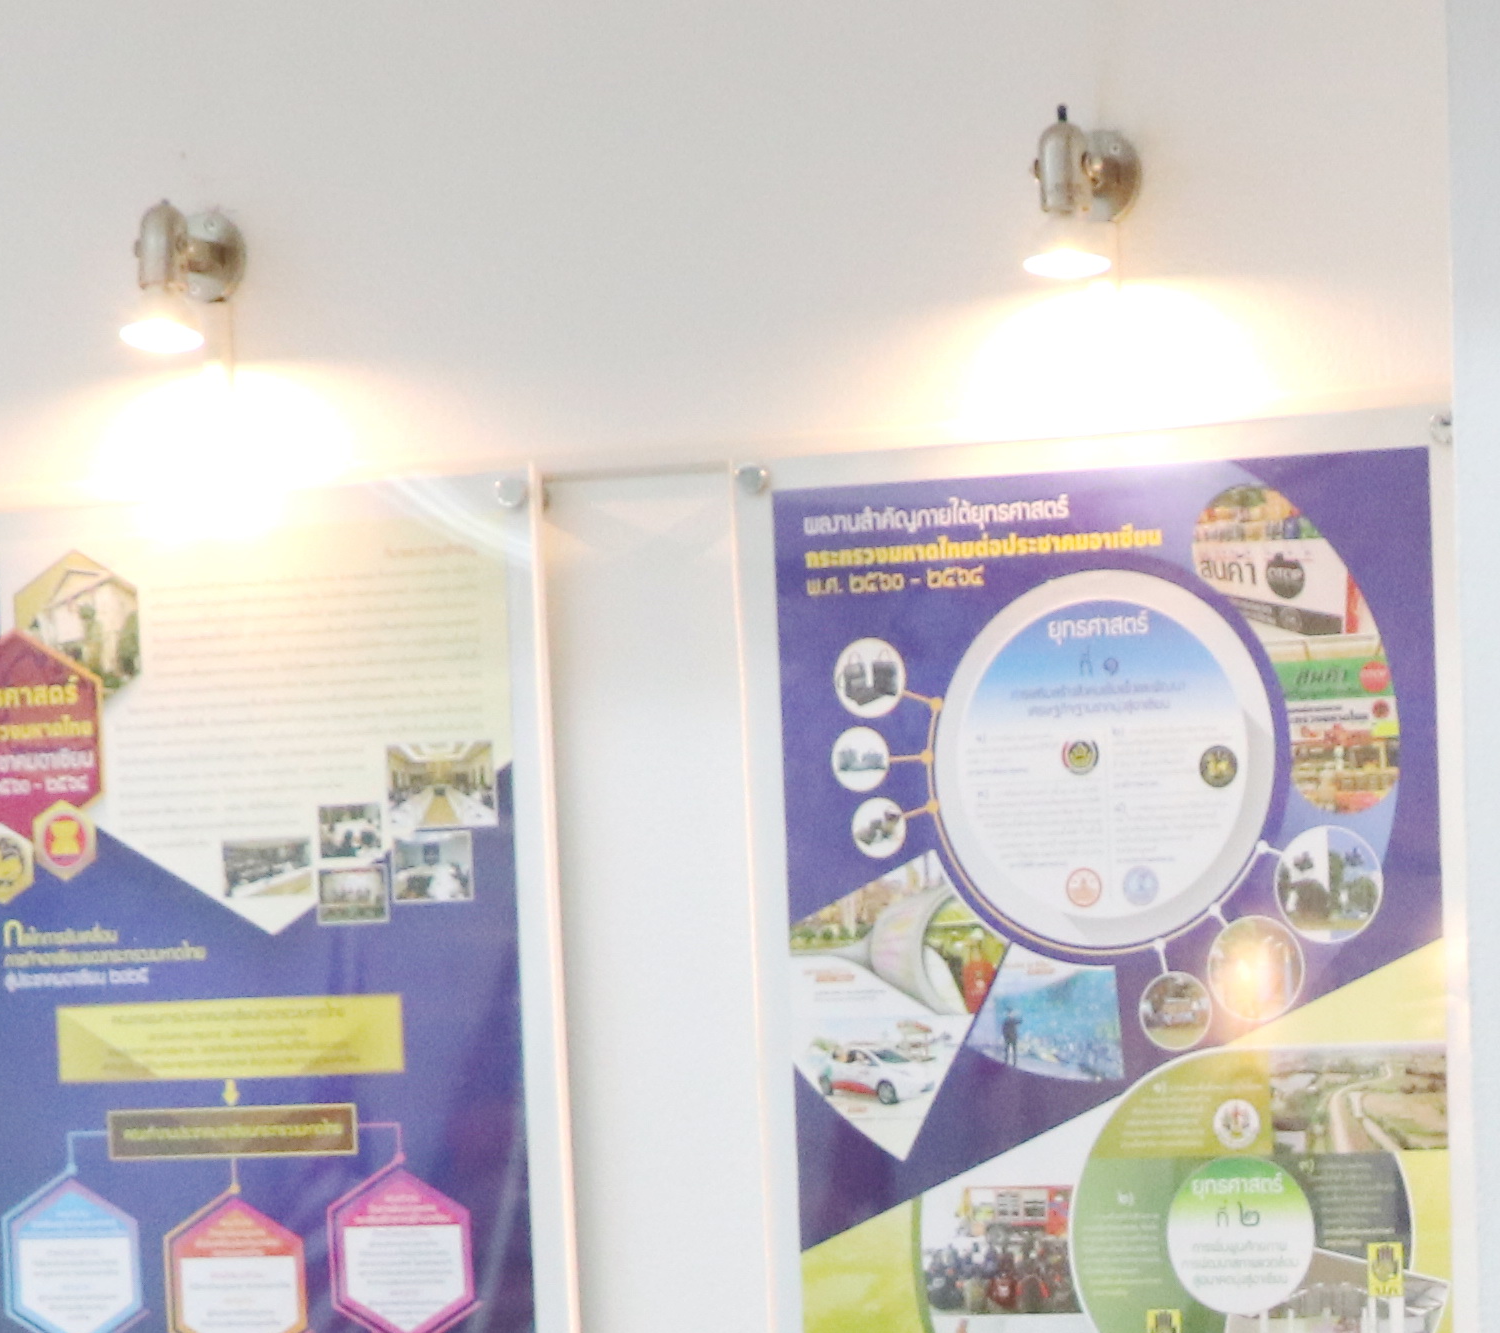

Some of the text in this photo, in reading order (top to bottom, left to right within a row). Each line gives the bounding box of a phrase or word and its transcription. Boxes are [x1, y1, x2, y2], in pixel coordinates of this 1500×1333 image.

[803, 493, 1070, 536] ผลงานสำคัญภายใต้ยุทธศาสตร์
[805, 524, 1163, 569] กระทรวงมหาดไทยต่อประชาคมอาเซียน
[1047, 608, 1149, 646] ยุทธศาสตร์
[1192, 1172, 1283, 1199] ยุทธศาสตร์
[1238, 1201, 1260, 1227] ๒
